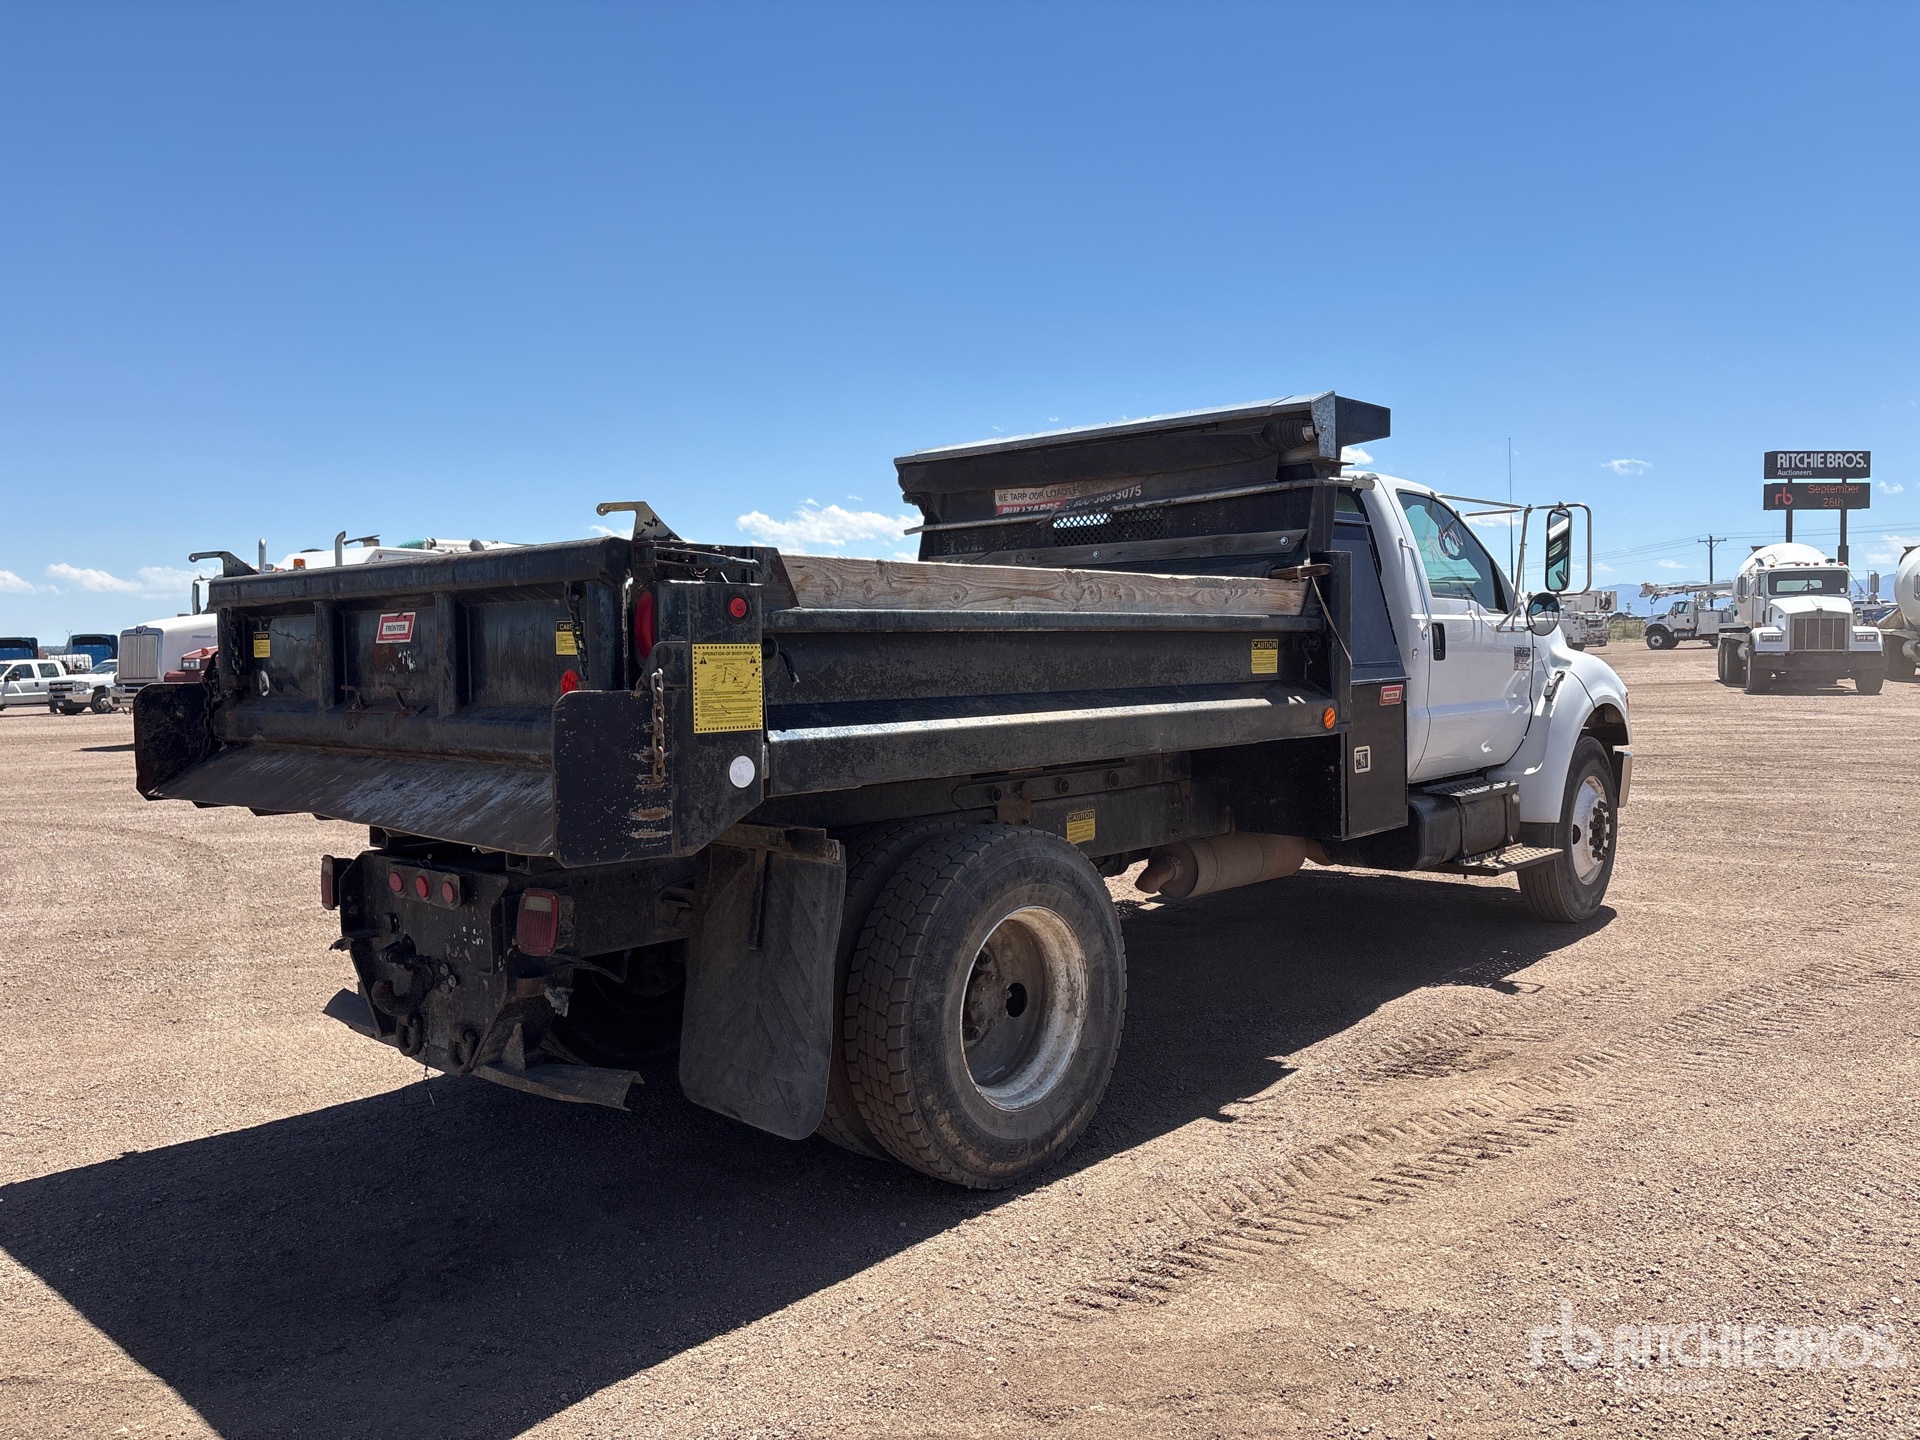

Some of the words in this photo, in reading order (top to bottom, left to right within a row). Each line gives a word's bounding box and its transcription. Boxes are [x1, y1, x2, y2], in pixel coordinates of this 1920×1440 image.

[1777, 453, 1824, 468] RITCHIE
[1826, 453, 1867, 468] BROS.
[1010, 493, 1027, 501] TARP
[1029, 492, 1044, 501] OUR
[1045, 487, 1072, 498] LOADS
[1808, 484, 1859, 495] September
[1774, 487, 1794, 505] rb
[1823, 497, 1844, 507] 26th
[1252, 641, 1277, 649] CAUTION
[1068, 811, 1094, 821] CAUTION
